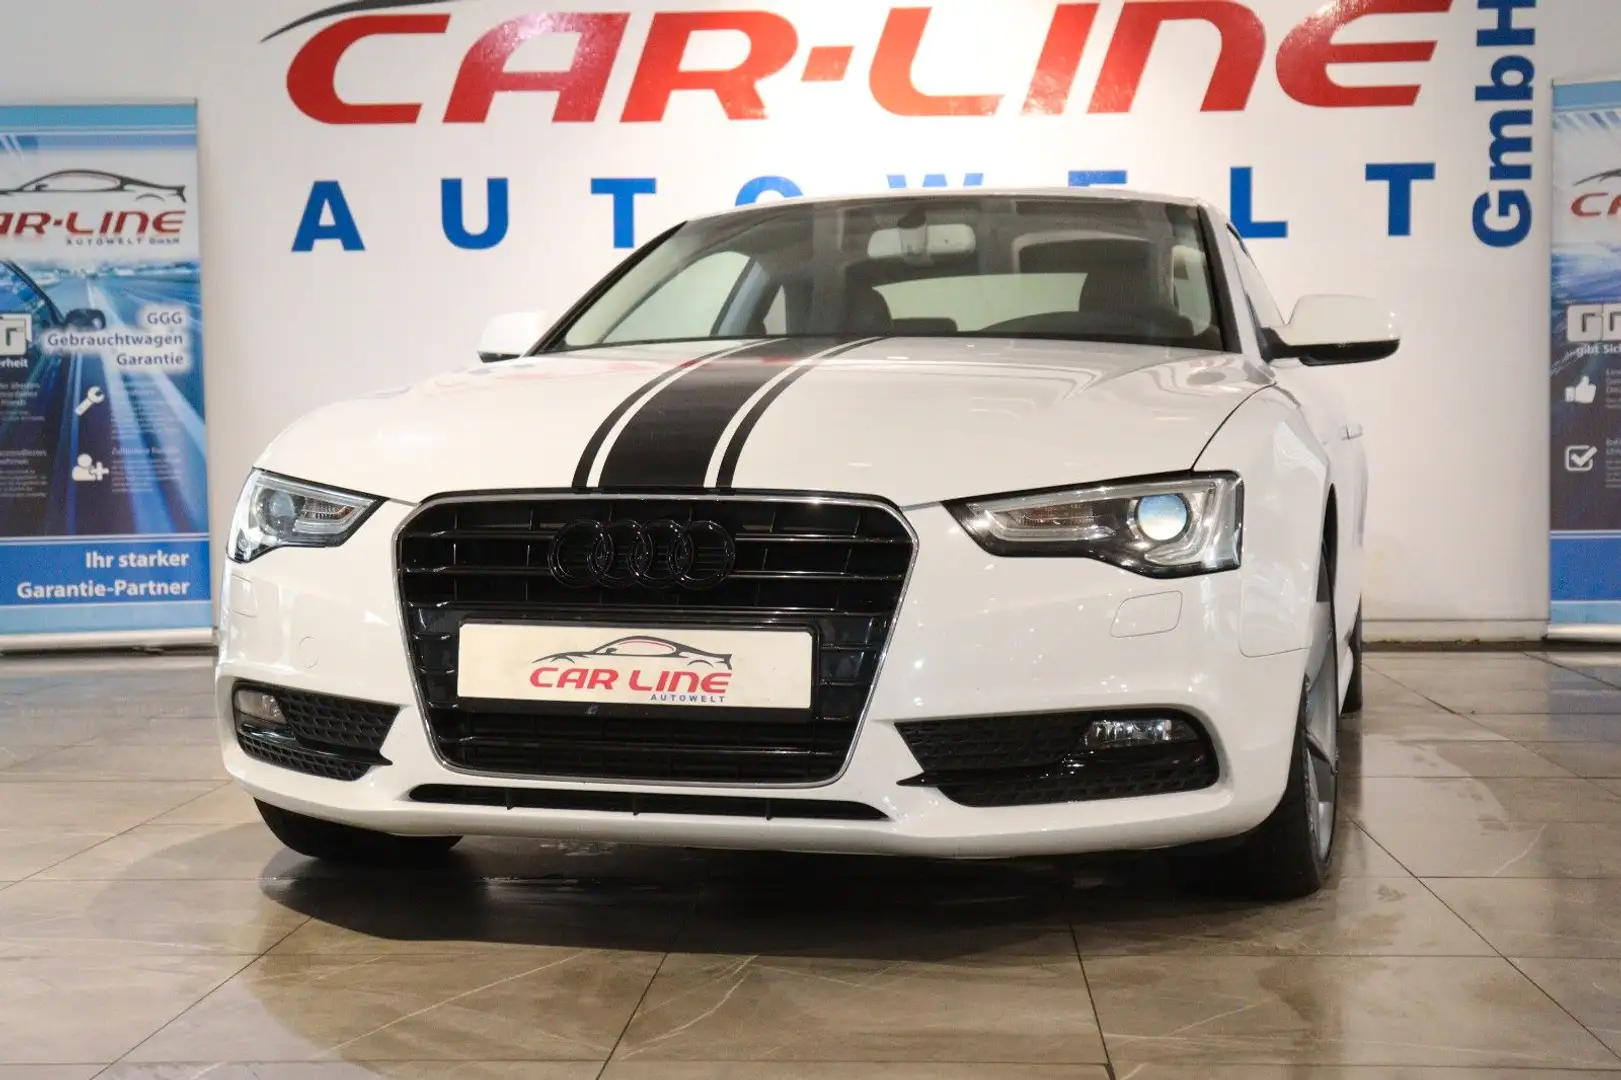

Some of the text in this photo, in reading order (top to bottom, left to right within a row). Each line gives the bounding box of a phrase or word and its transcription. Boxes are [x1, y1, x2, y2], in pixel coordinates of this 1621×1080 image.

[286, 0, 1452, 124] CAR-LINE
[1472, 0, 1537, 248] GmbH
[66, 237, 142, 246] AUTOWELT
[147, 312, 182, 325] GGG
[47, 332, 183, 348] Gebrauchtwagen
[116, 352, 184, 366] Garantie
[85, 550, 189, 568] Ihr starker
[17, 579, 191, 599] Garantie-Partner
[530, 667, 732, 693] CAR LINE
[651, 694, 726, 703] AUTOWELT
